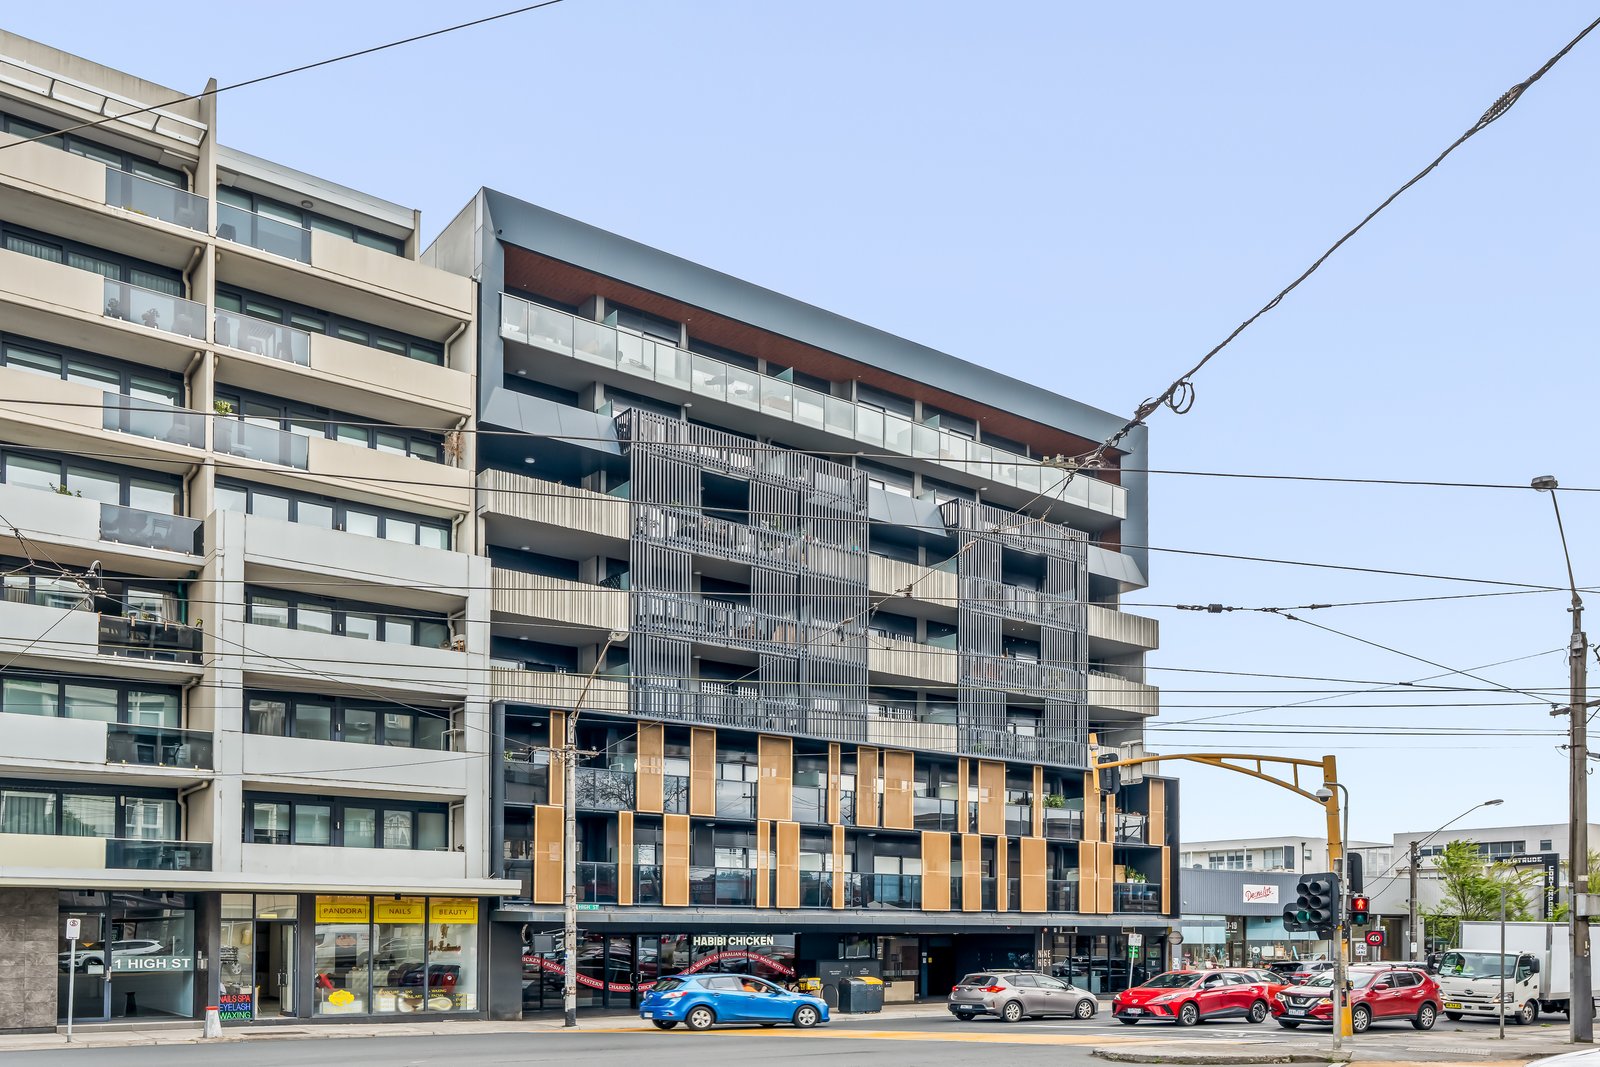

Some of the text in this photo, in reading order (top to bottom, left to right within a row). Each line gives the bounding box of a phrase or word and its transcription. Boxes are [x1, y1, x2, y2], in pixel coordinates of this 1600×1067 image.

[693, 936, 774, 946] HABIBI CHICKEN
[115, 958, 191, 969] 1 HIGH ST
[238, 994, 251, 1002] SPA
[220, 1003, 250, 1011] EYELASH
[220, 1011, 250, 1019] WAXING
